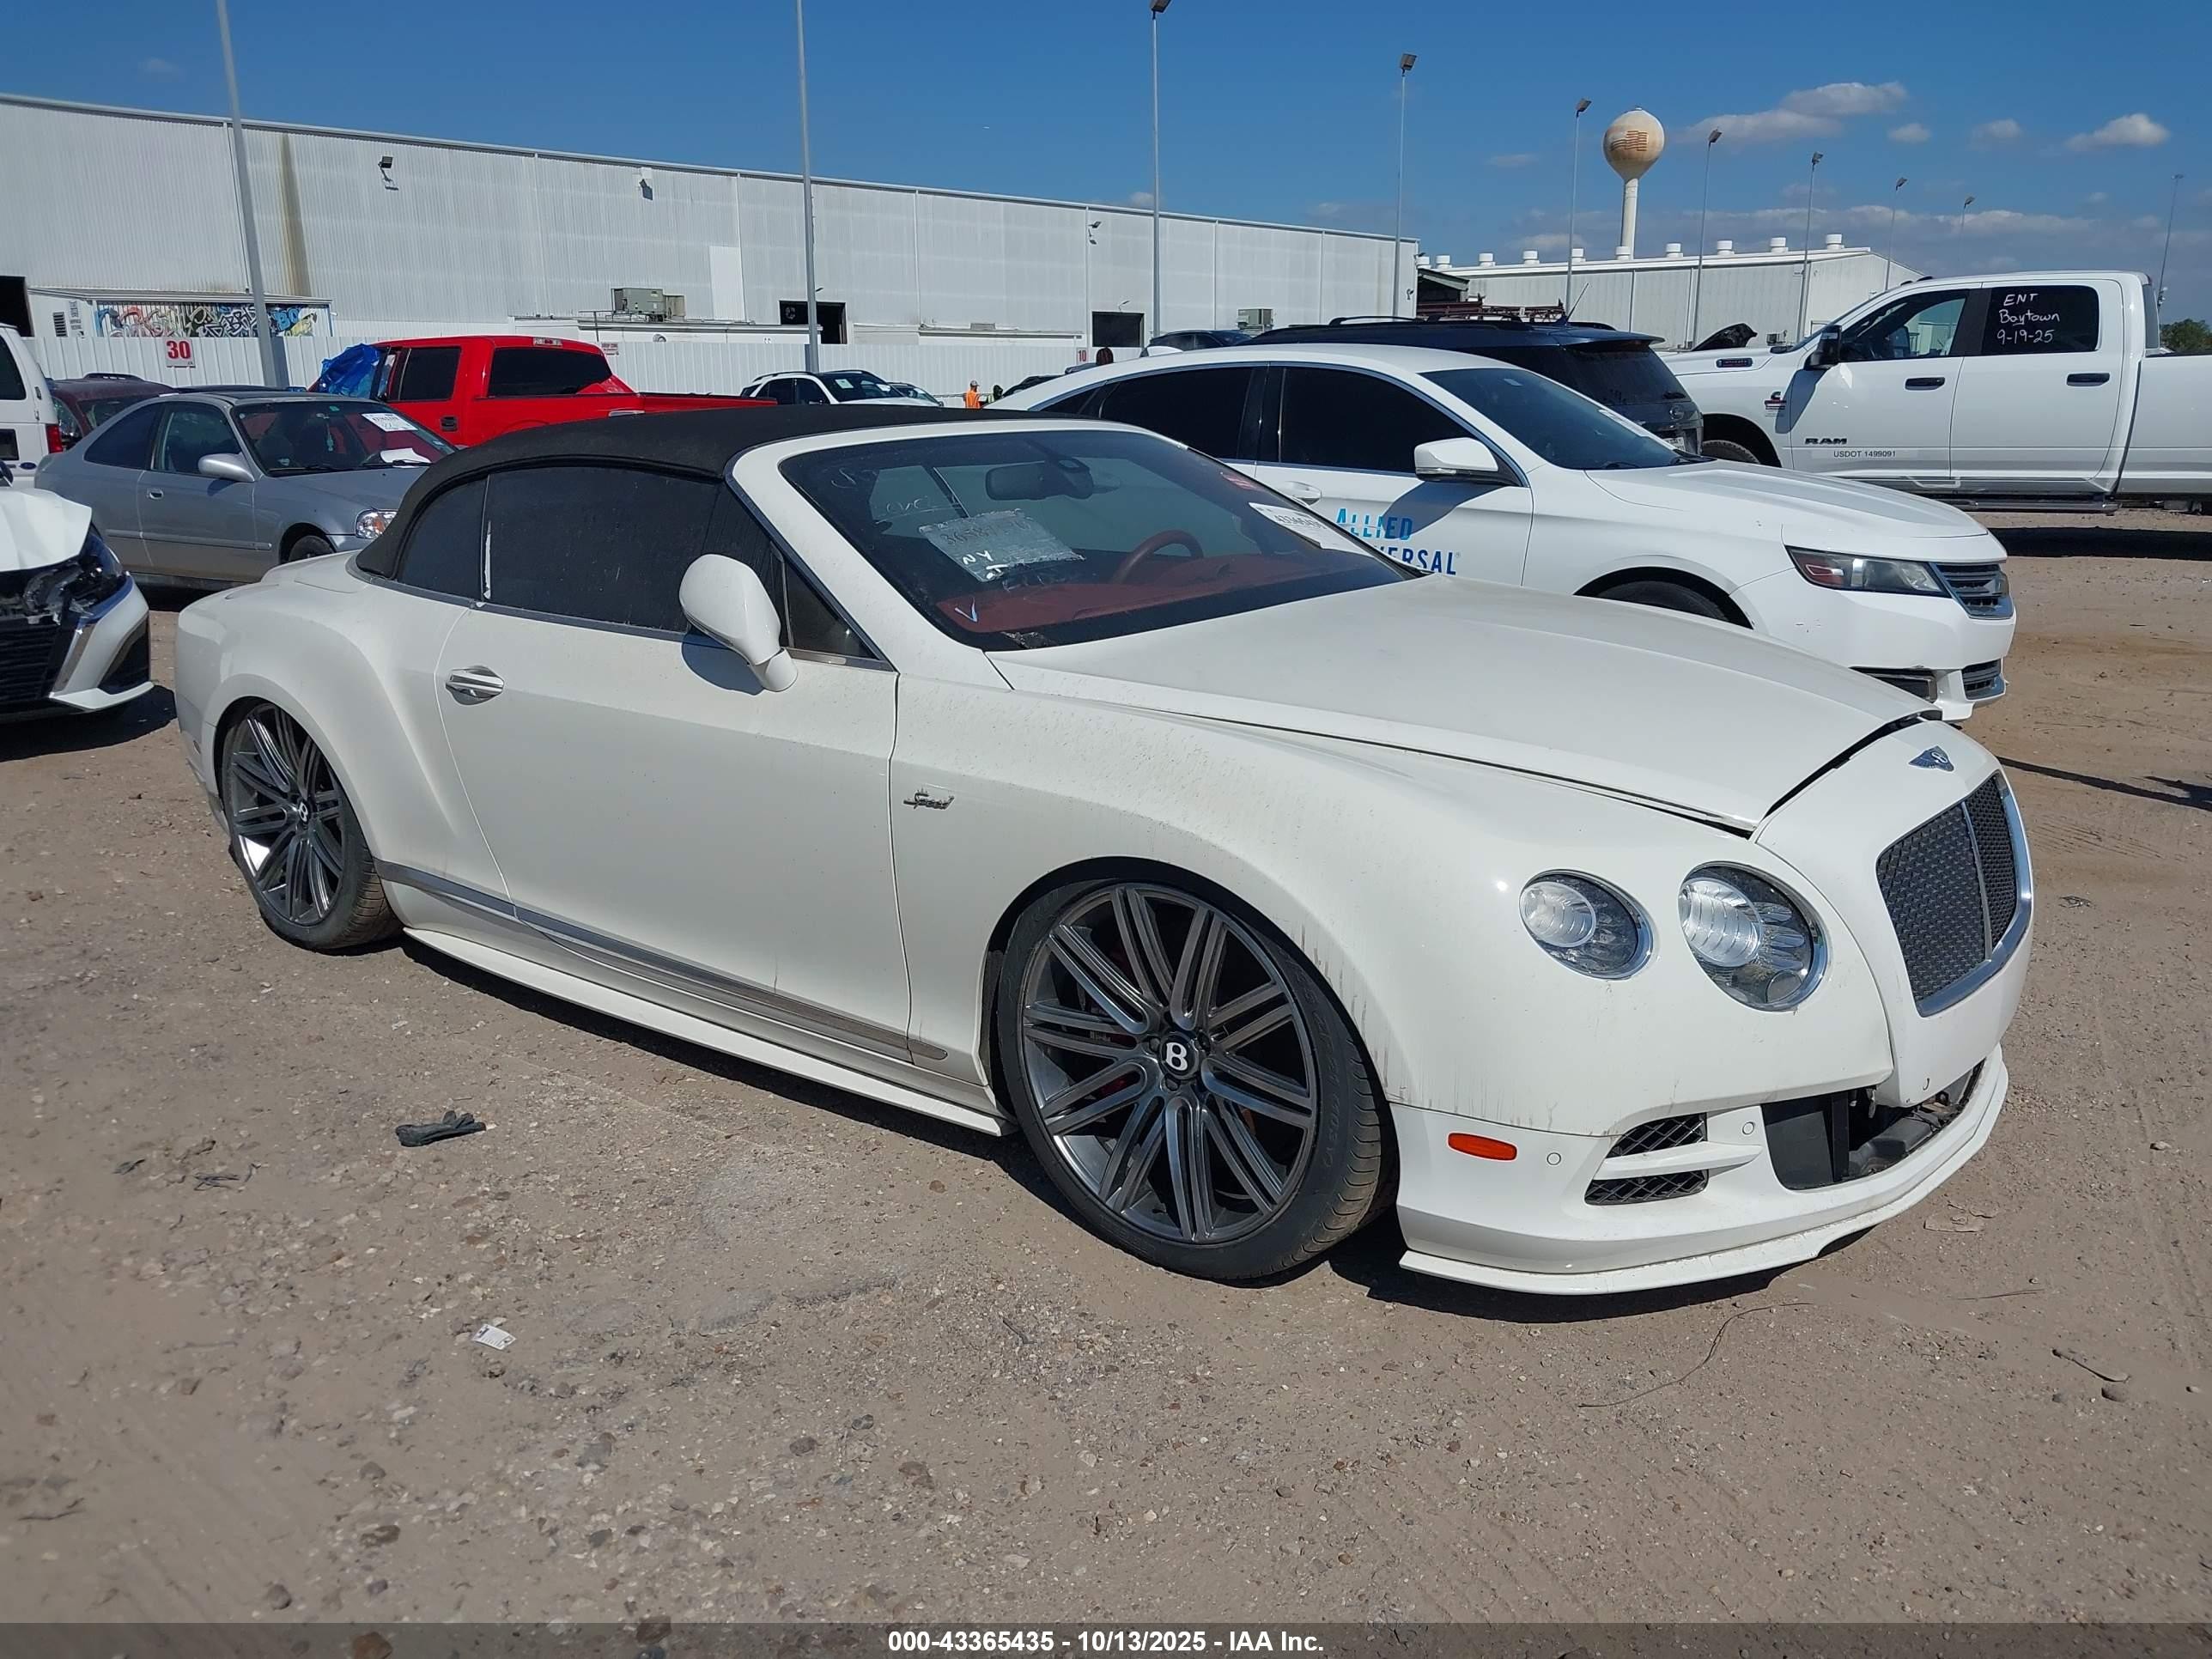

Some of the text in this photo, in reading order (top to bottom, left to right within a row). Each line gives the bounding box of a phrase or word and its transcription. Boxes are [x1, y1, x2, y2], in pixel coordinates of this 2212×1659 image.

[2003, 293, 2039, 307] ENT
[1996, 329, 2055, 345] 9-19-25
[166, 340, 191, 359] 30
[1078, 349, 1087, 362] 10
[1336, 507, 1413, 540] ALLIED
[1165, 1042, 1188, 1072] B
